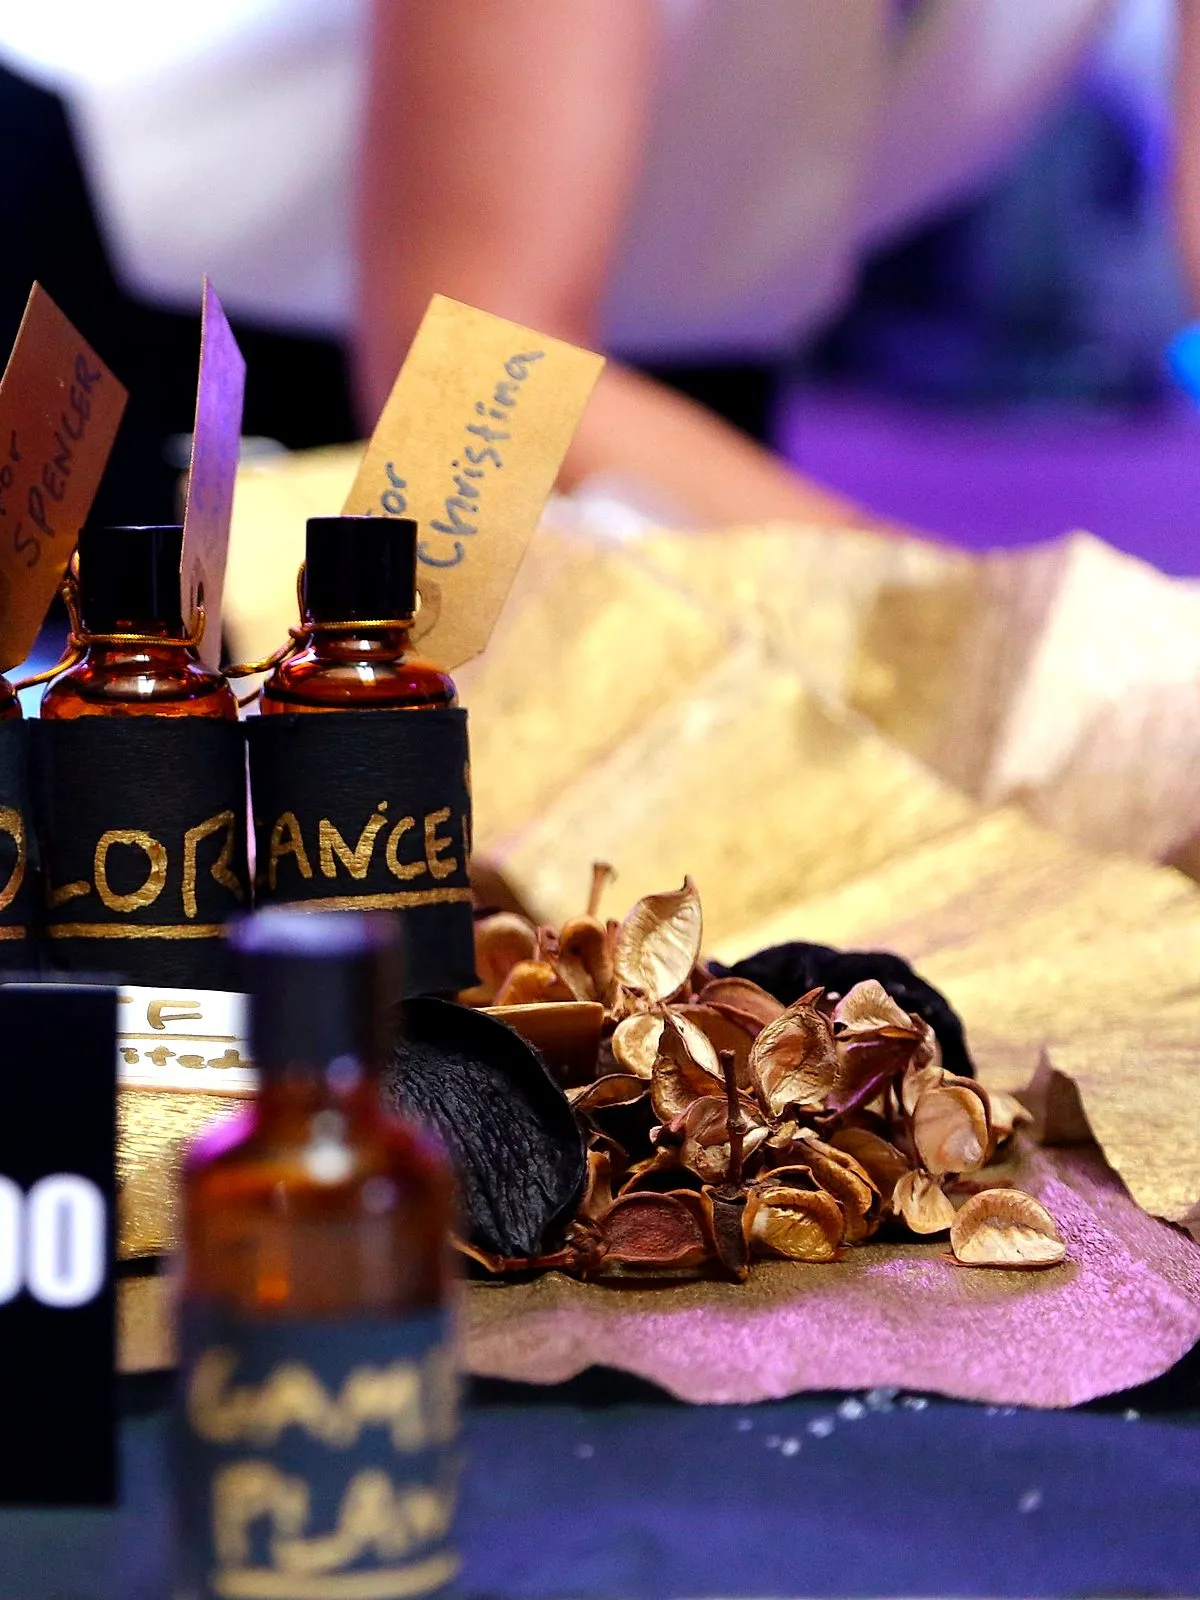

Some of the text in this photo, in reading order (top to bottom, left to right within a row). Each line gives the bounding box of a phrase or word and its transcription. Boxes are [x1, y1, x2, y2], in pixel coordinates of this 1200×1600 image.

[13, 352, 102, 567] SPENCER
[367, 461, 408, 519] or
[416, 349, 546, 569] Christina
